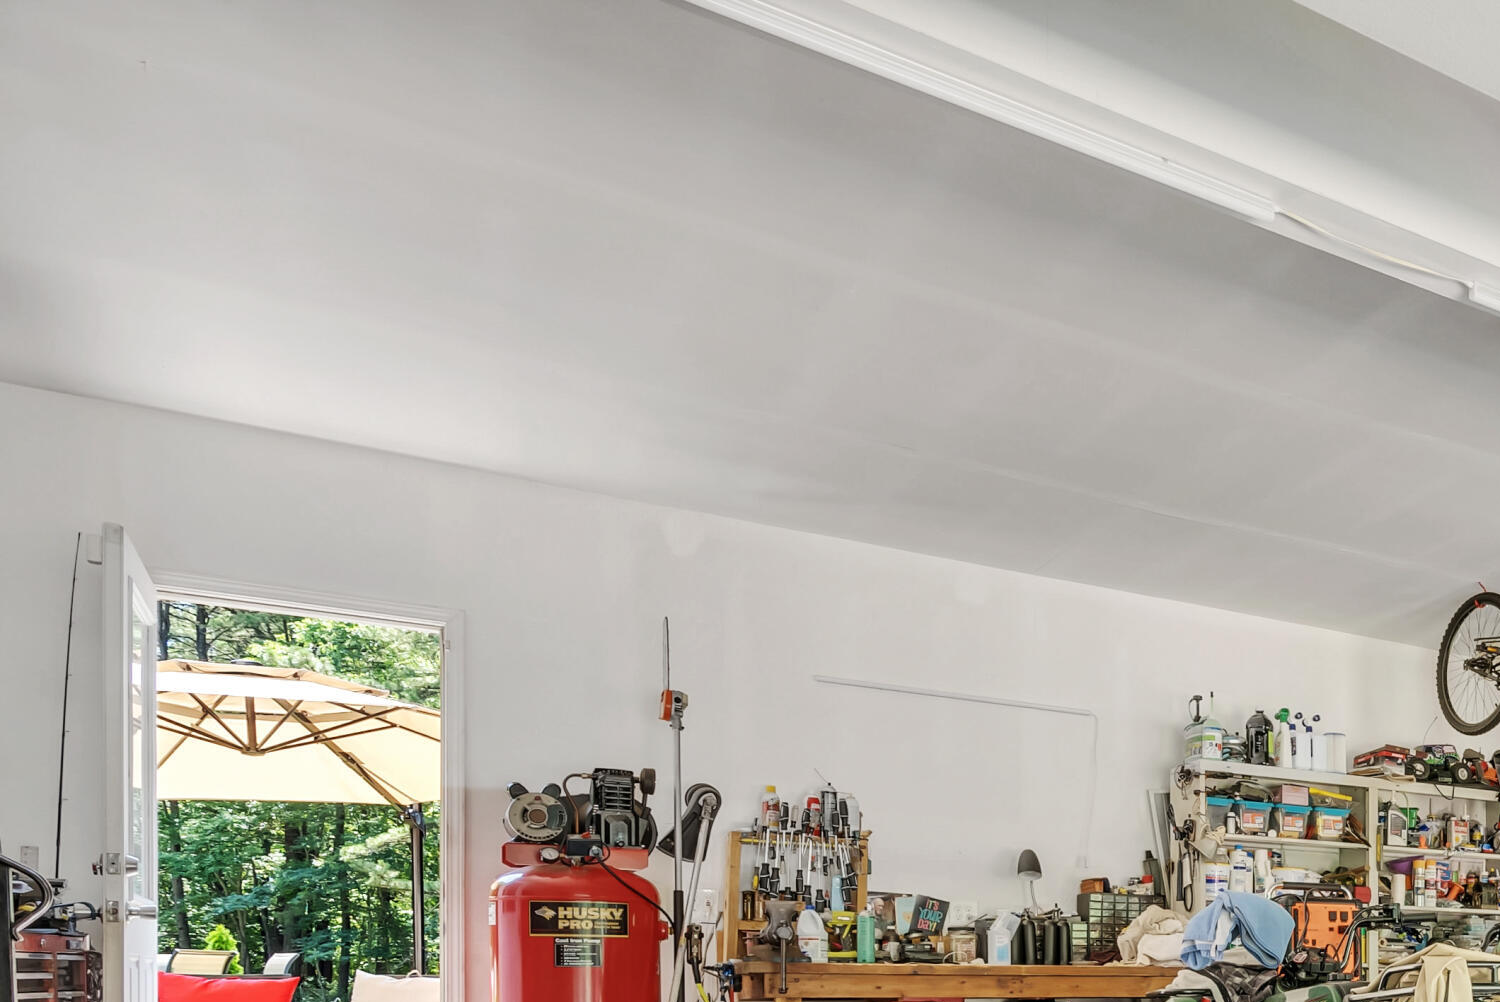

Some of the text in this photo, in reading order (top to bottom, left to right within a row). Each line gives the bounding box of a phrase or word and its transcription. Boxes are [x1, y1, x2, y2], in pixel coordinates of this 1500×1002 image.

[557, 906, 624, 920] HUSKY
[919, 907, 943, 923] YOUR
[558, 920, 593, 930] PRO
